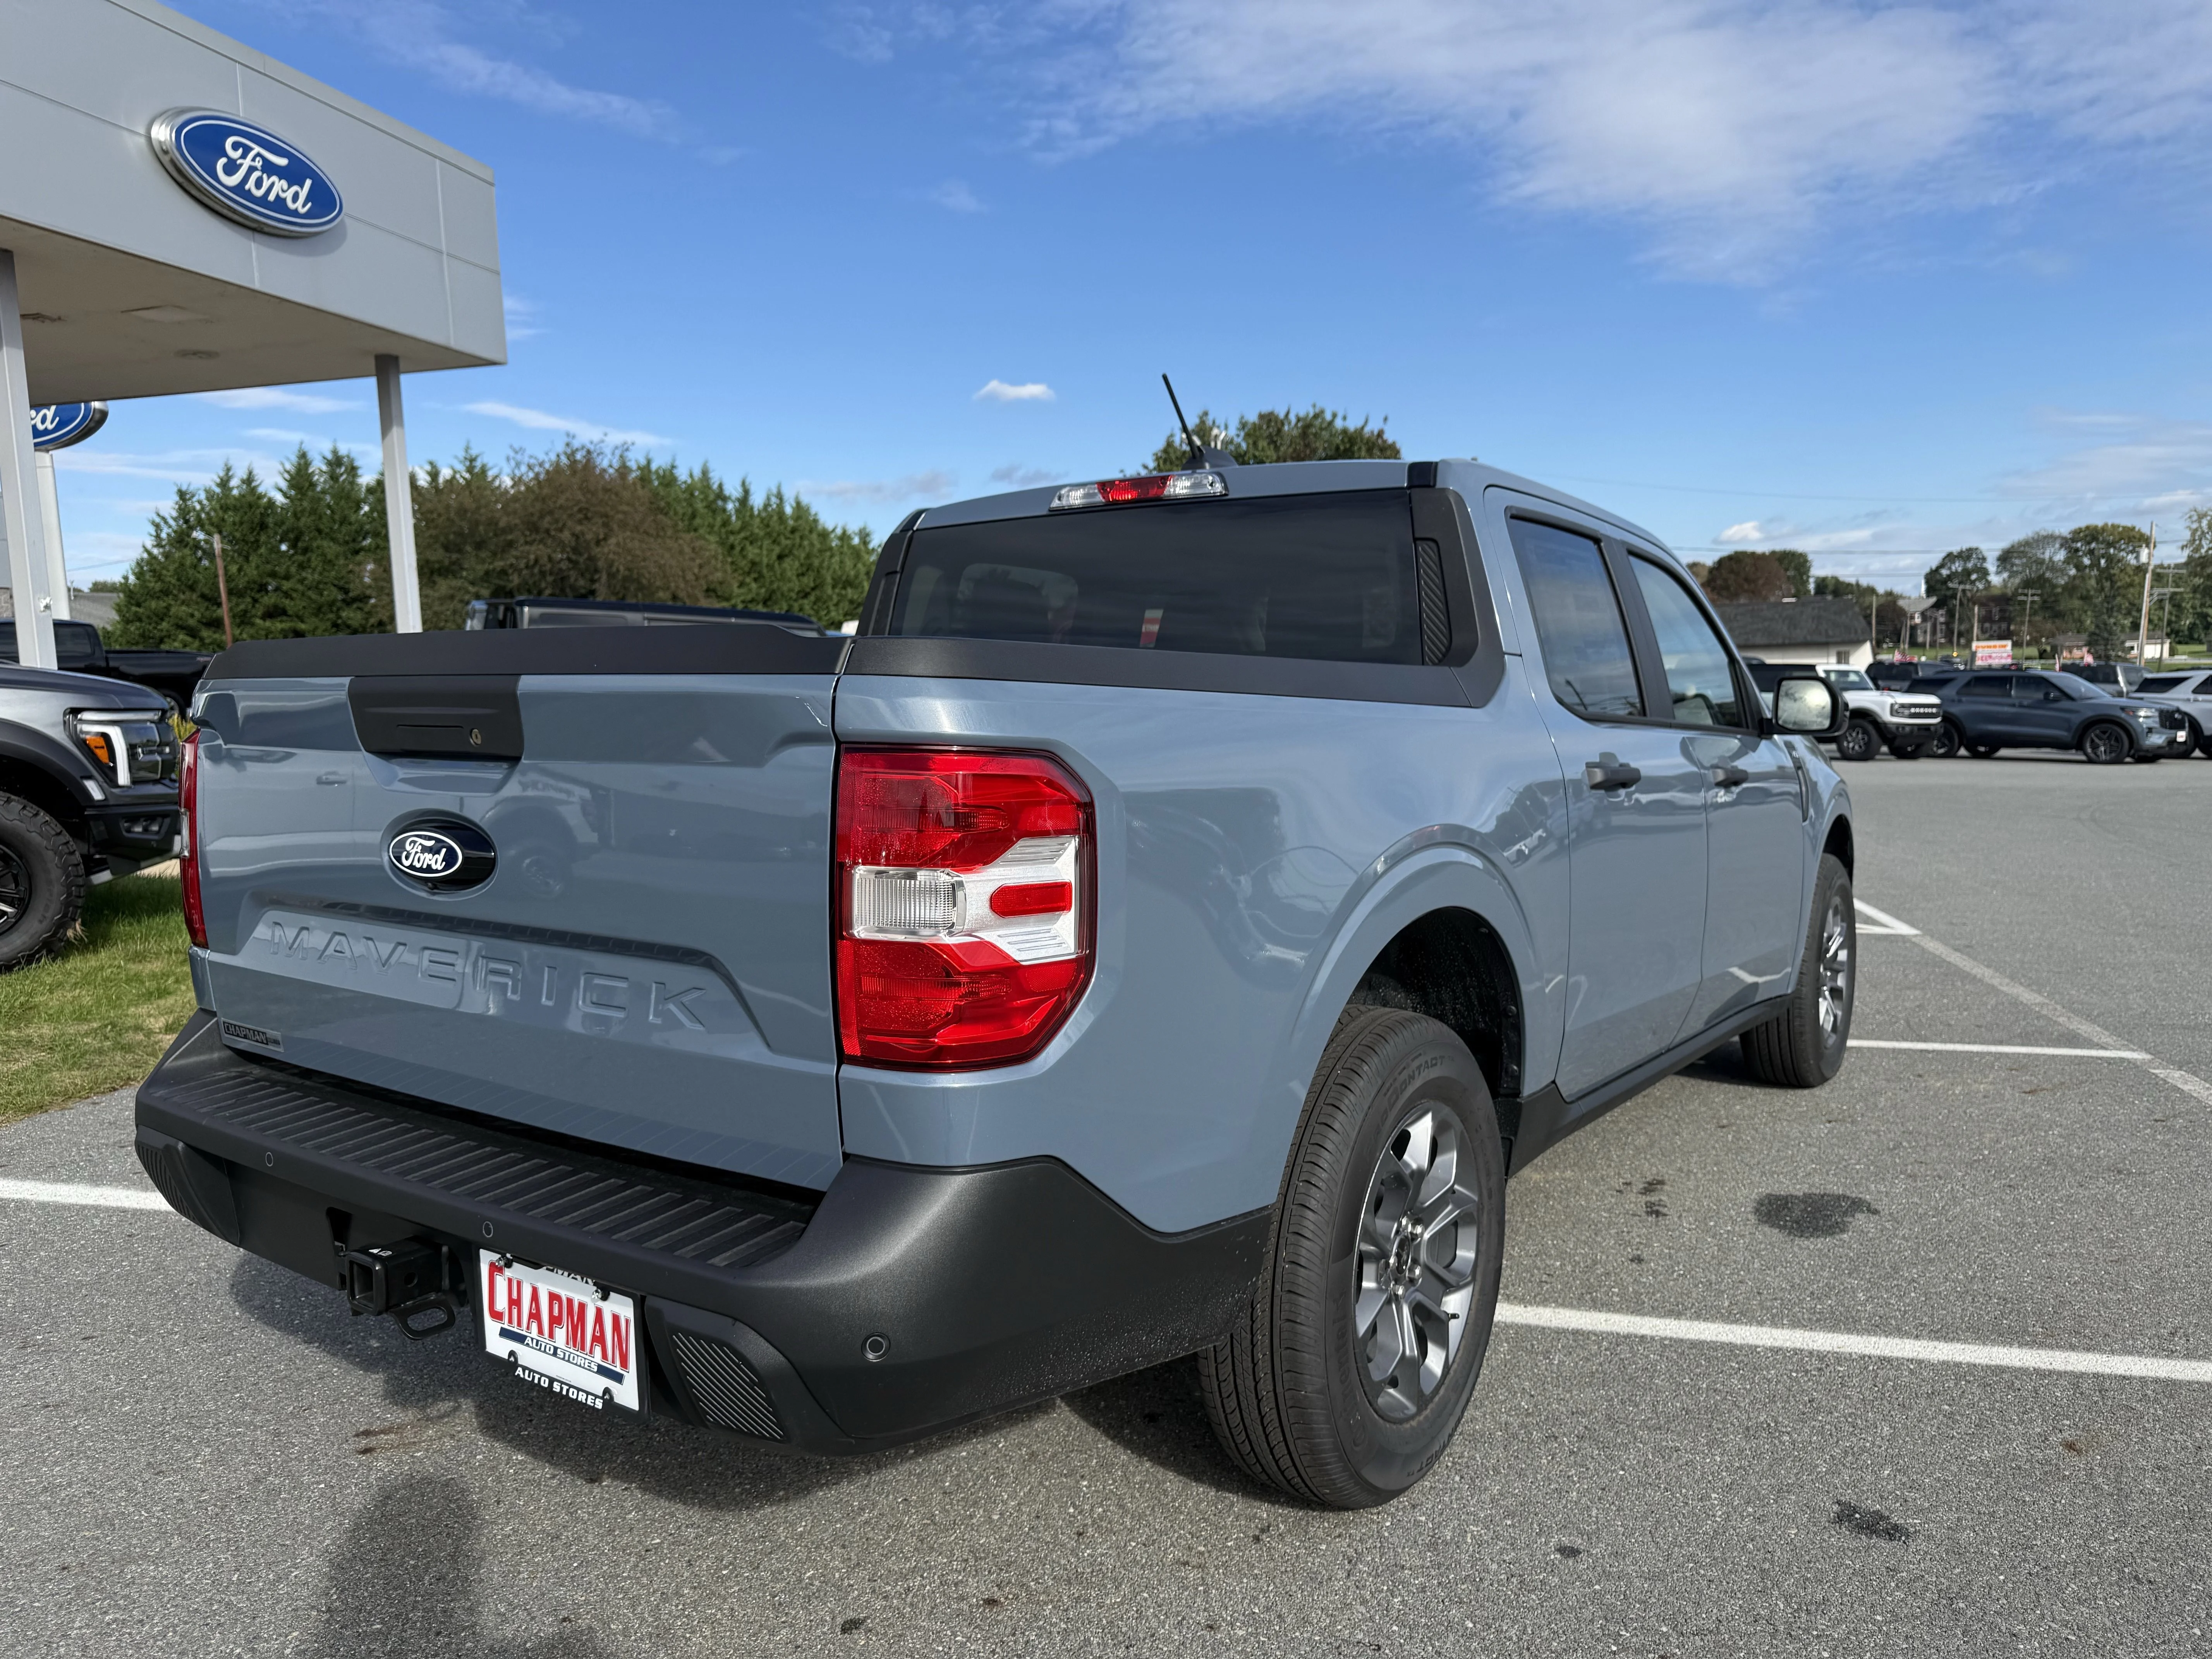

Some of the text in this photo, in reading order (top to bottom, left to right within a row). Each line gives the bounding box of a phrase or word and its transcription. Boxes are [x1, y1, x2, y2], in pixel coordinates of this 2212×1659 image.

[216, 136, 312, 214] Ford
[401, 836, 447, 871] Ford
[270, 921, 706, 1030] MAVERICK
[224, 1023, 268, 1045] CHAPMAN
[488, 1259, 631, 1372] CHAPMAN
[524, 1336, 598, 1372] AUTO STORES
[515, 1367, 603, 1410] AUTO STORES
